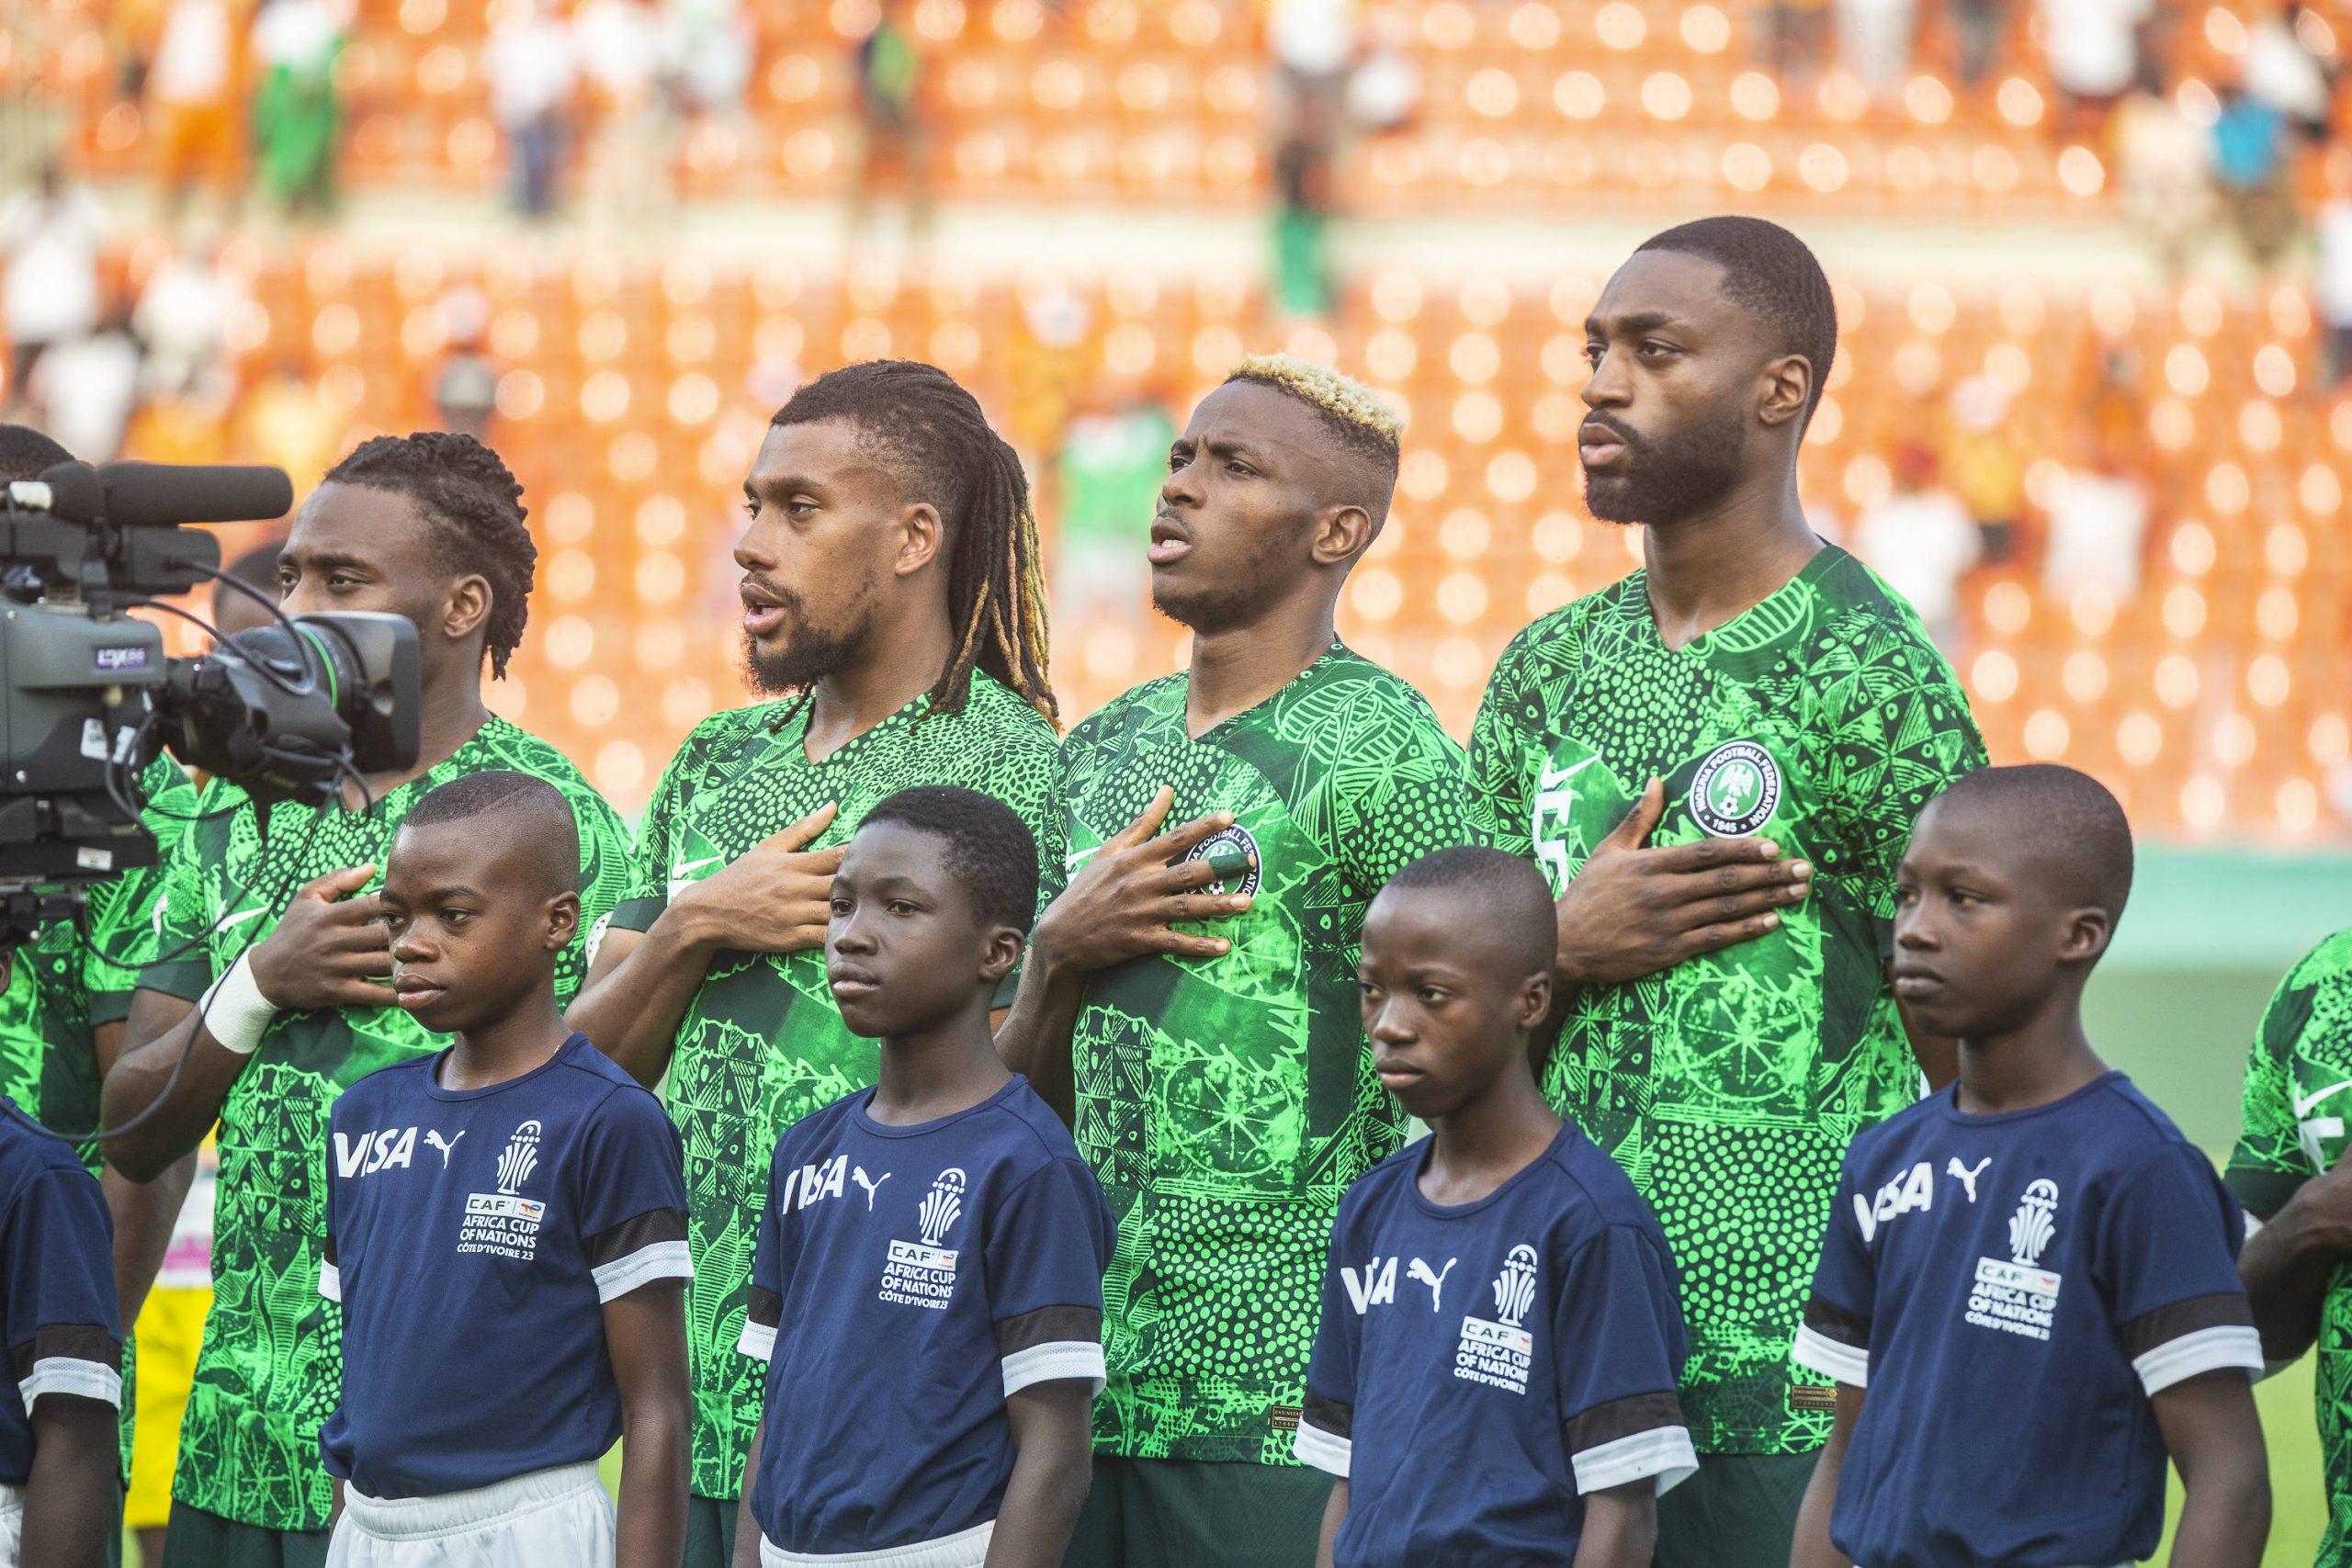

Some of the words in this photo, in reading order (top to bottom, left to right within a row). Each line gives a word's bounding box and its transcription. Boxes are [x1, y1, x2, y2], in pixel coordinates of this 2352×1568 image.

[1709, 747, 1762, 769] FOOTBALL
[1748, 759, 1777, 827] FEDERATION
[1712, 818, 1737, 833] 1945
[333, 1126, 418, 1179] VISA
[469, 1199, 505, 1211] CAF
[462, 1214, 506, 1230] AFRICA
[510, 1219, 540, 1235] CUP
[459, 1228, 476, 1241] OF
[476, 1229, 537, 1249] NATIONS
[457, 1242, 476, 1253] CÔTE
[476, 1244, 520, 1258] D'IVOIRE
[521, 1250, 535, 1260] 23
[892, 1246, 931, 1261] CAF
[883, 1261, 929, 1281] AFRICA
[930, 1269, 956, 1284] CUP
[1982, 1265, 2022, 1280] CAF
[881, 1275, 902, 1291] OF
[901, 1279, 955, 1299] NATIONS
[878, 1290, 905, 1303] CÔTE
[1466, 1324, 1509, 1339] CAF
[1457, 1338, 1510, 1362] AFRICA
[1455, 1352, 1478, 1368] OF
